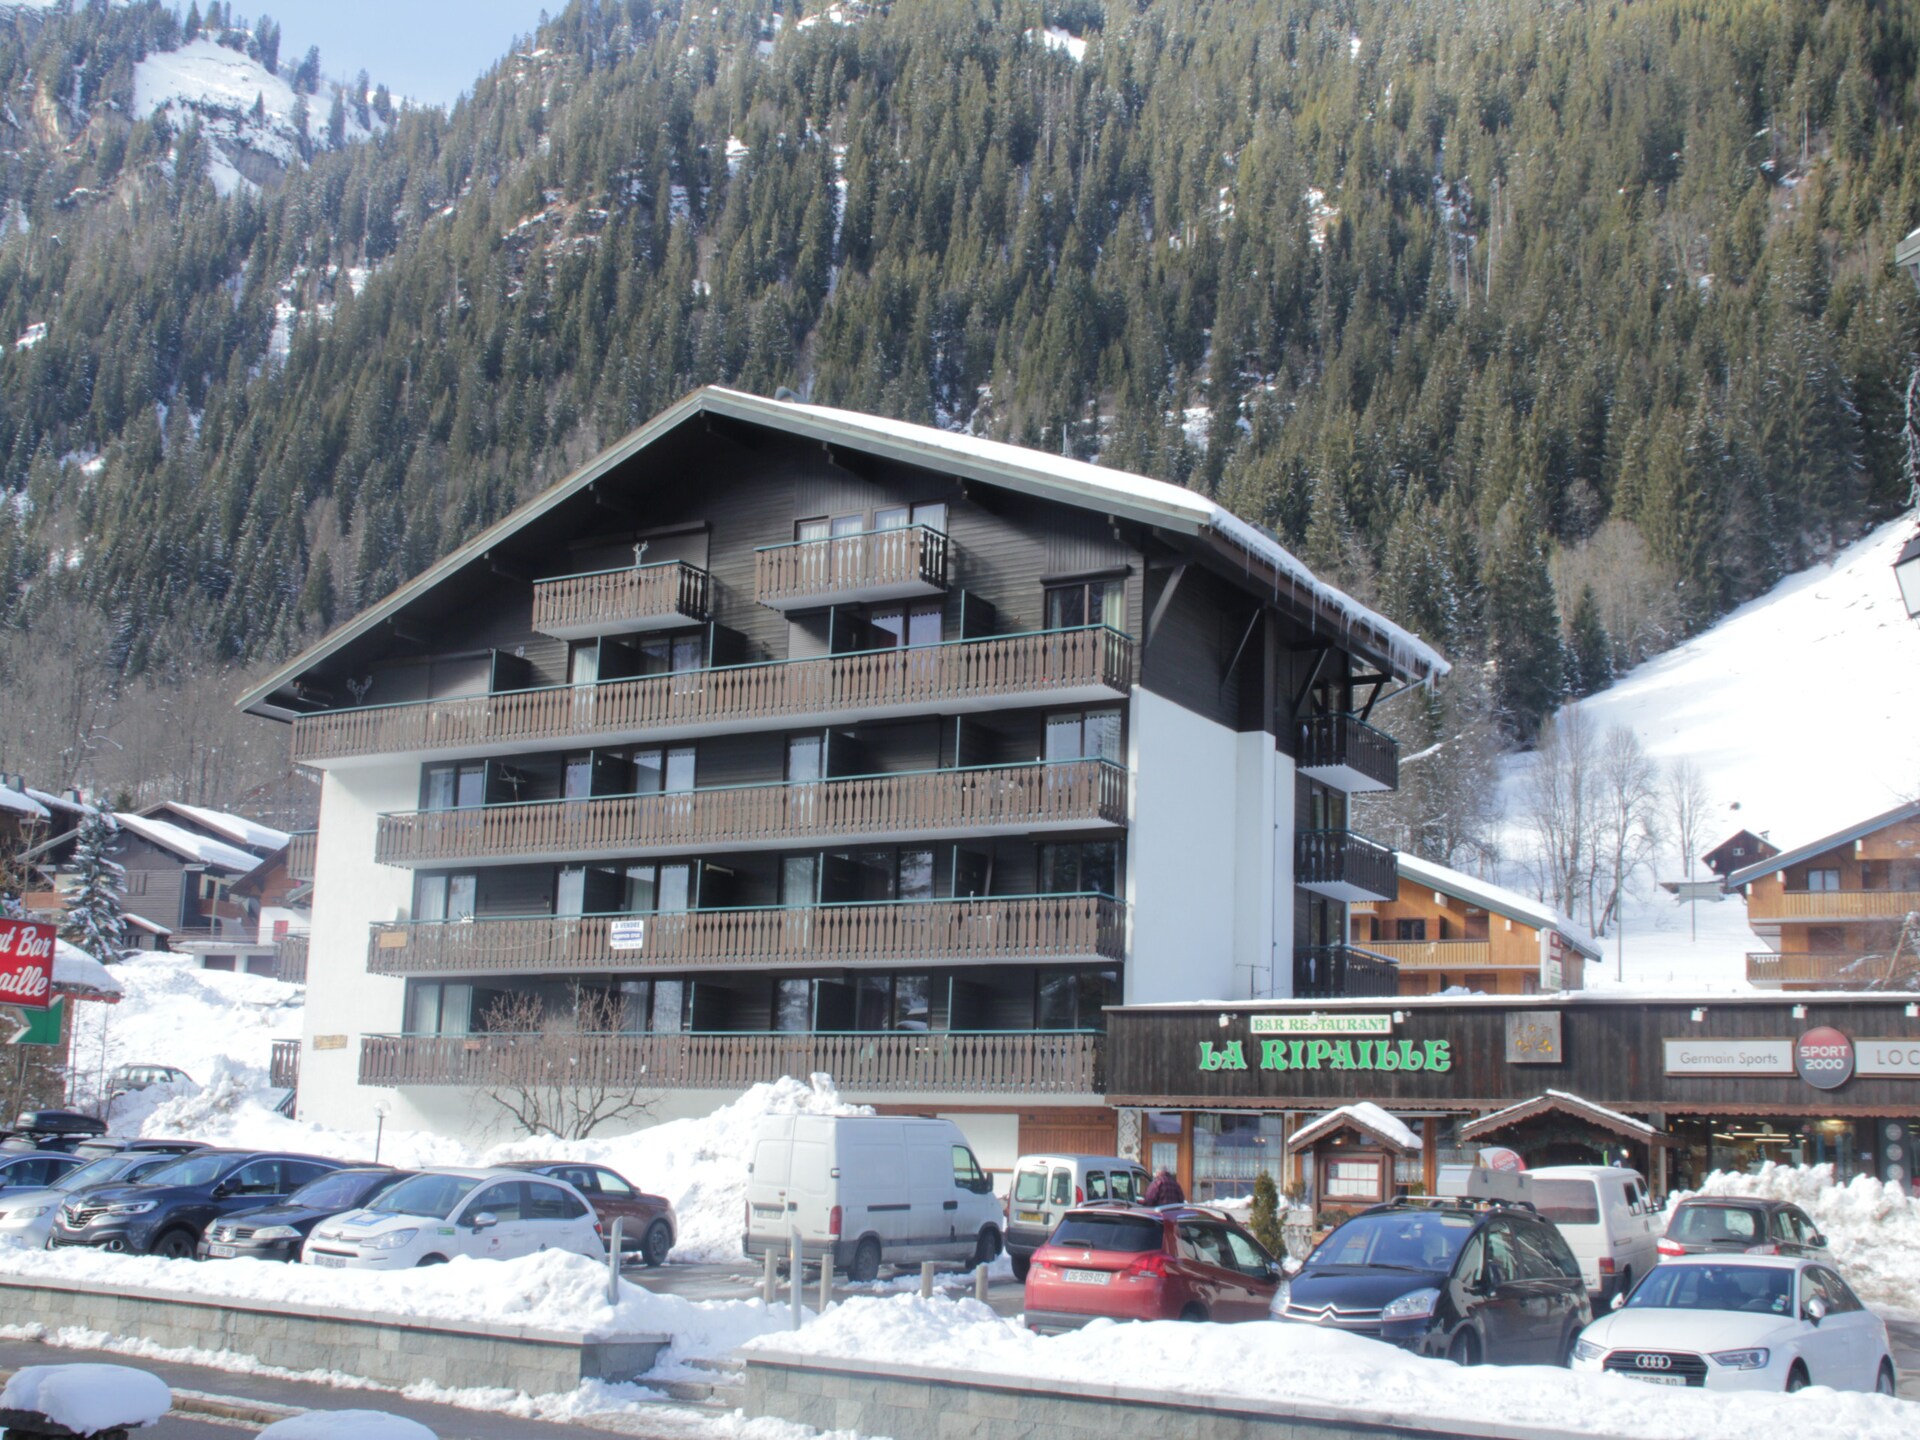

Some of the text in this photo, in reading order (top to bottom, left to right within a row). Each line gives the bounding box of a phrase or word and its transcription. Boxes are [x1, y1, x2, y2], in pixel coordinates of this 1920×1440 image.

[16, 926, 52, 957] Bar
[1254, 1018, 1388, 1031] BAR RESTAURANT
[1199, 1039, 1451, 1072] LA RIPAILLE
[1800, 1045, 1848, 1057] SPORT
[1680, 1052, 1778, 1067] Germain Sports
[1805, 1058, 1845, 1070] 2000
